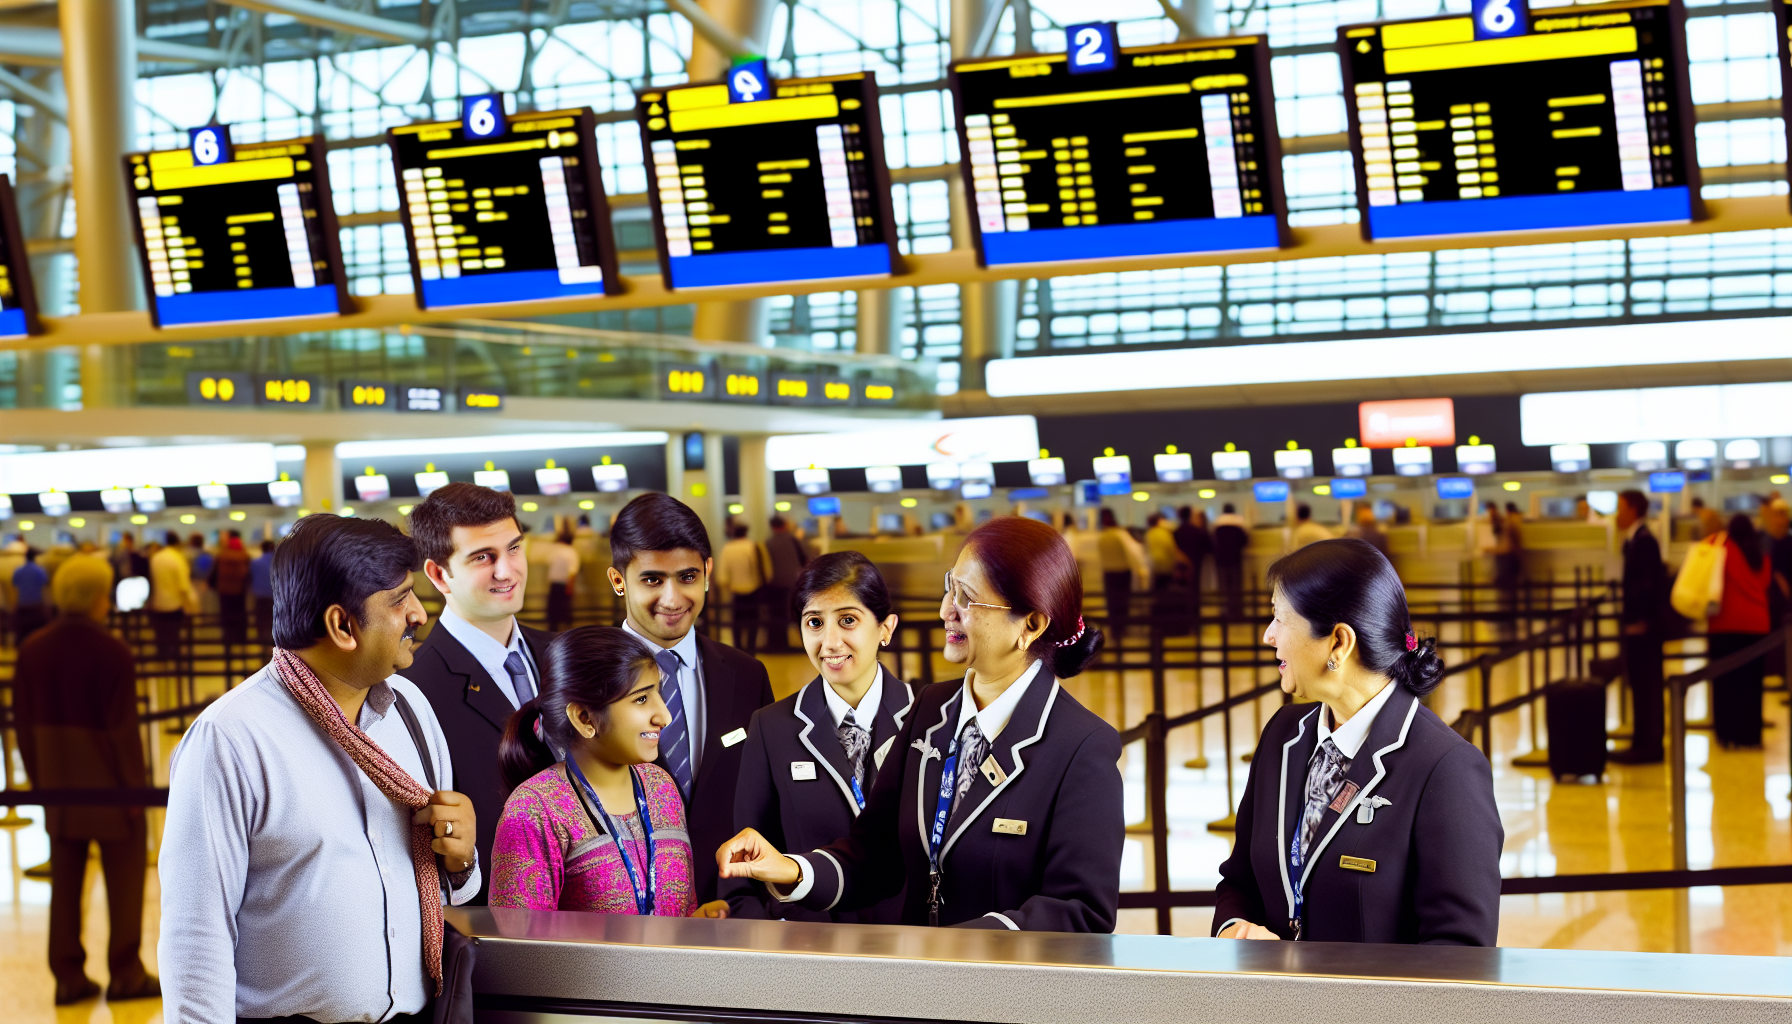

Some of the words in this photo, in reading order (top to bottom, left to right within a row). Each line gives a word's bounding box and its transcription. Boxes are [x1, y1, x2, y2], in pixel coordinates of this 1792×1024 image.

[1482, 0, 1516, 33] 6
[1075, 27, 1106, 66] 2
[469, 98, 496, 136] 6
[194, 129, 219, 164] 6
